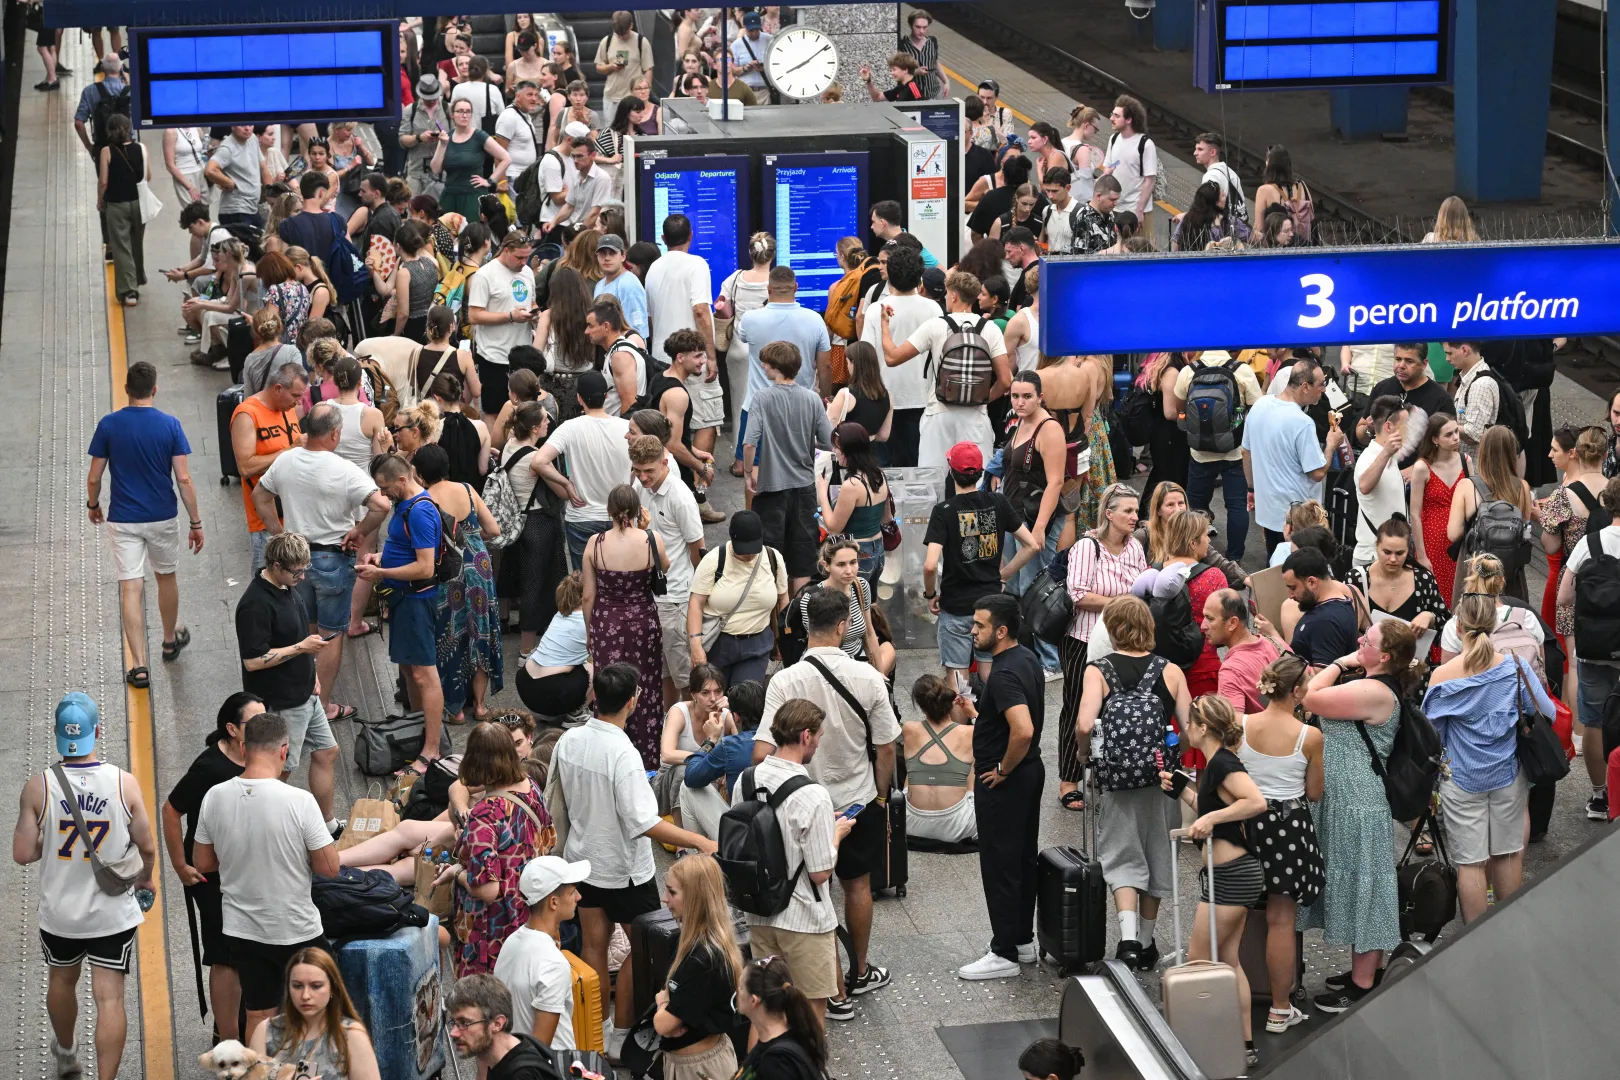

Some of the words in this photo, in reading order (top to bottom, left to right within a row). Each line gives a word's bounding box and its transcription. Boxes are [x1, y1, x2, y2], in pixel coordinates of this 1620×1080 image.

[776, 168, 806, 176] Przyjazdy
[1297, 273, 1336, 328] 3
[1349, 302, 1437, 332] peron
[1452, 291, 1579, 328] platform
[60, 792, 108, 815] DNČIĆ
[58, 819, 112, 861] 77
